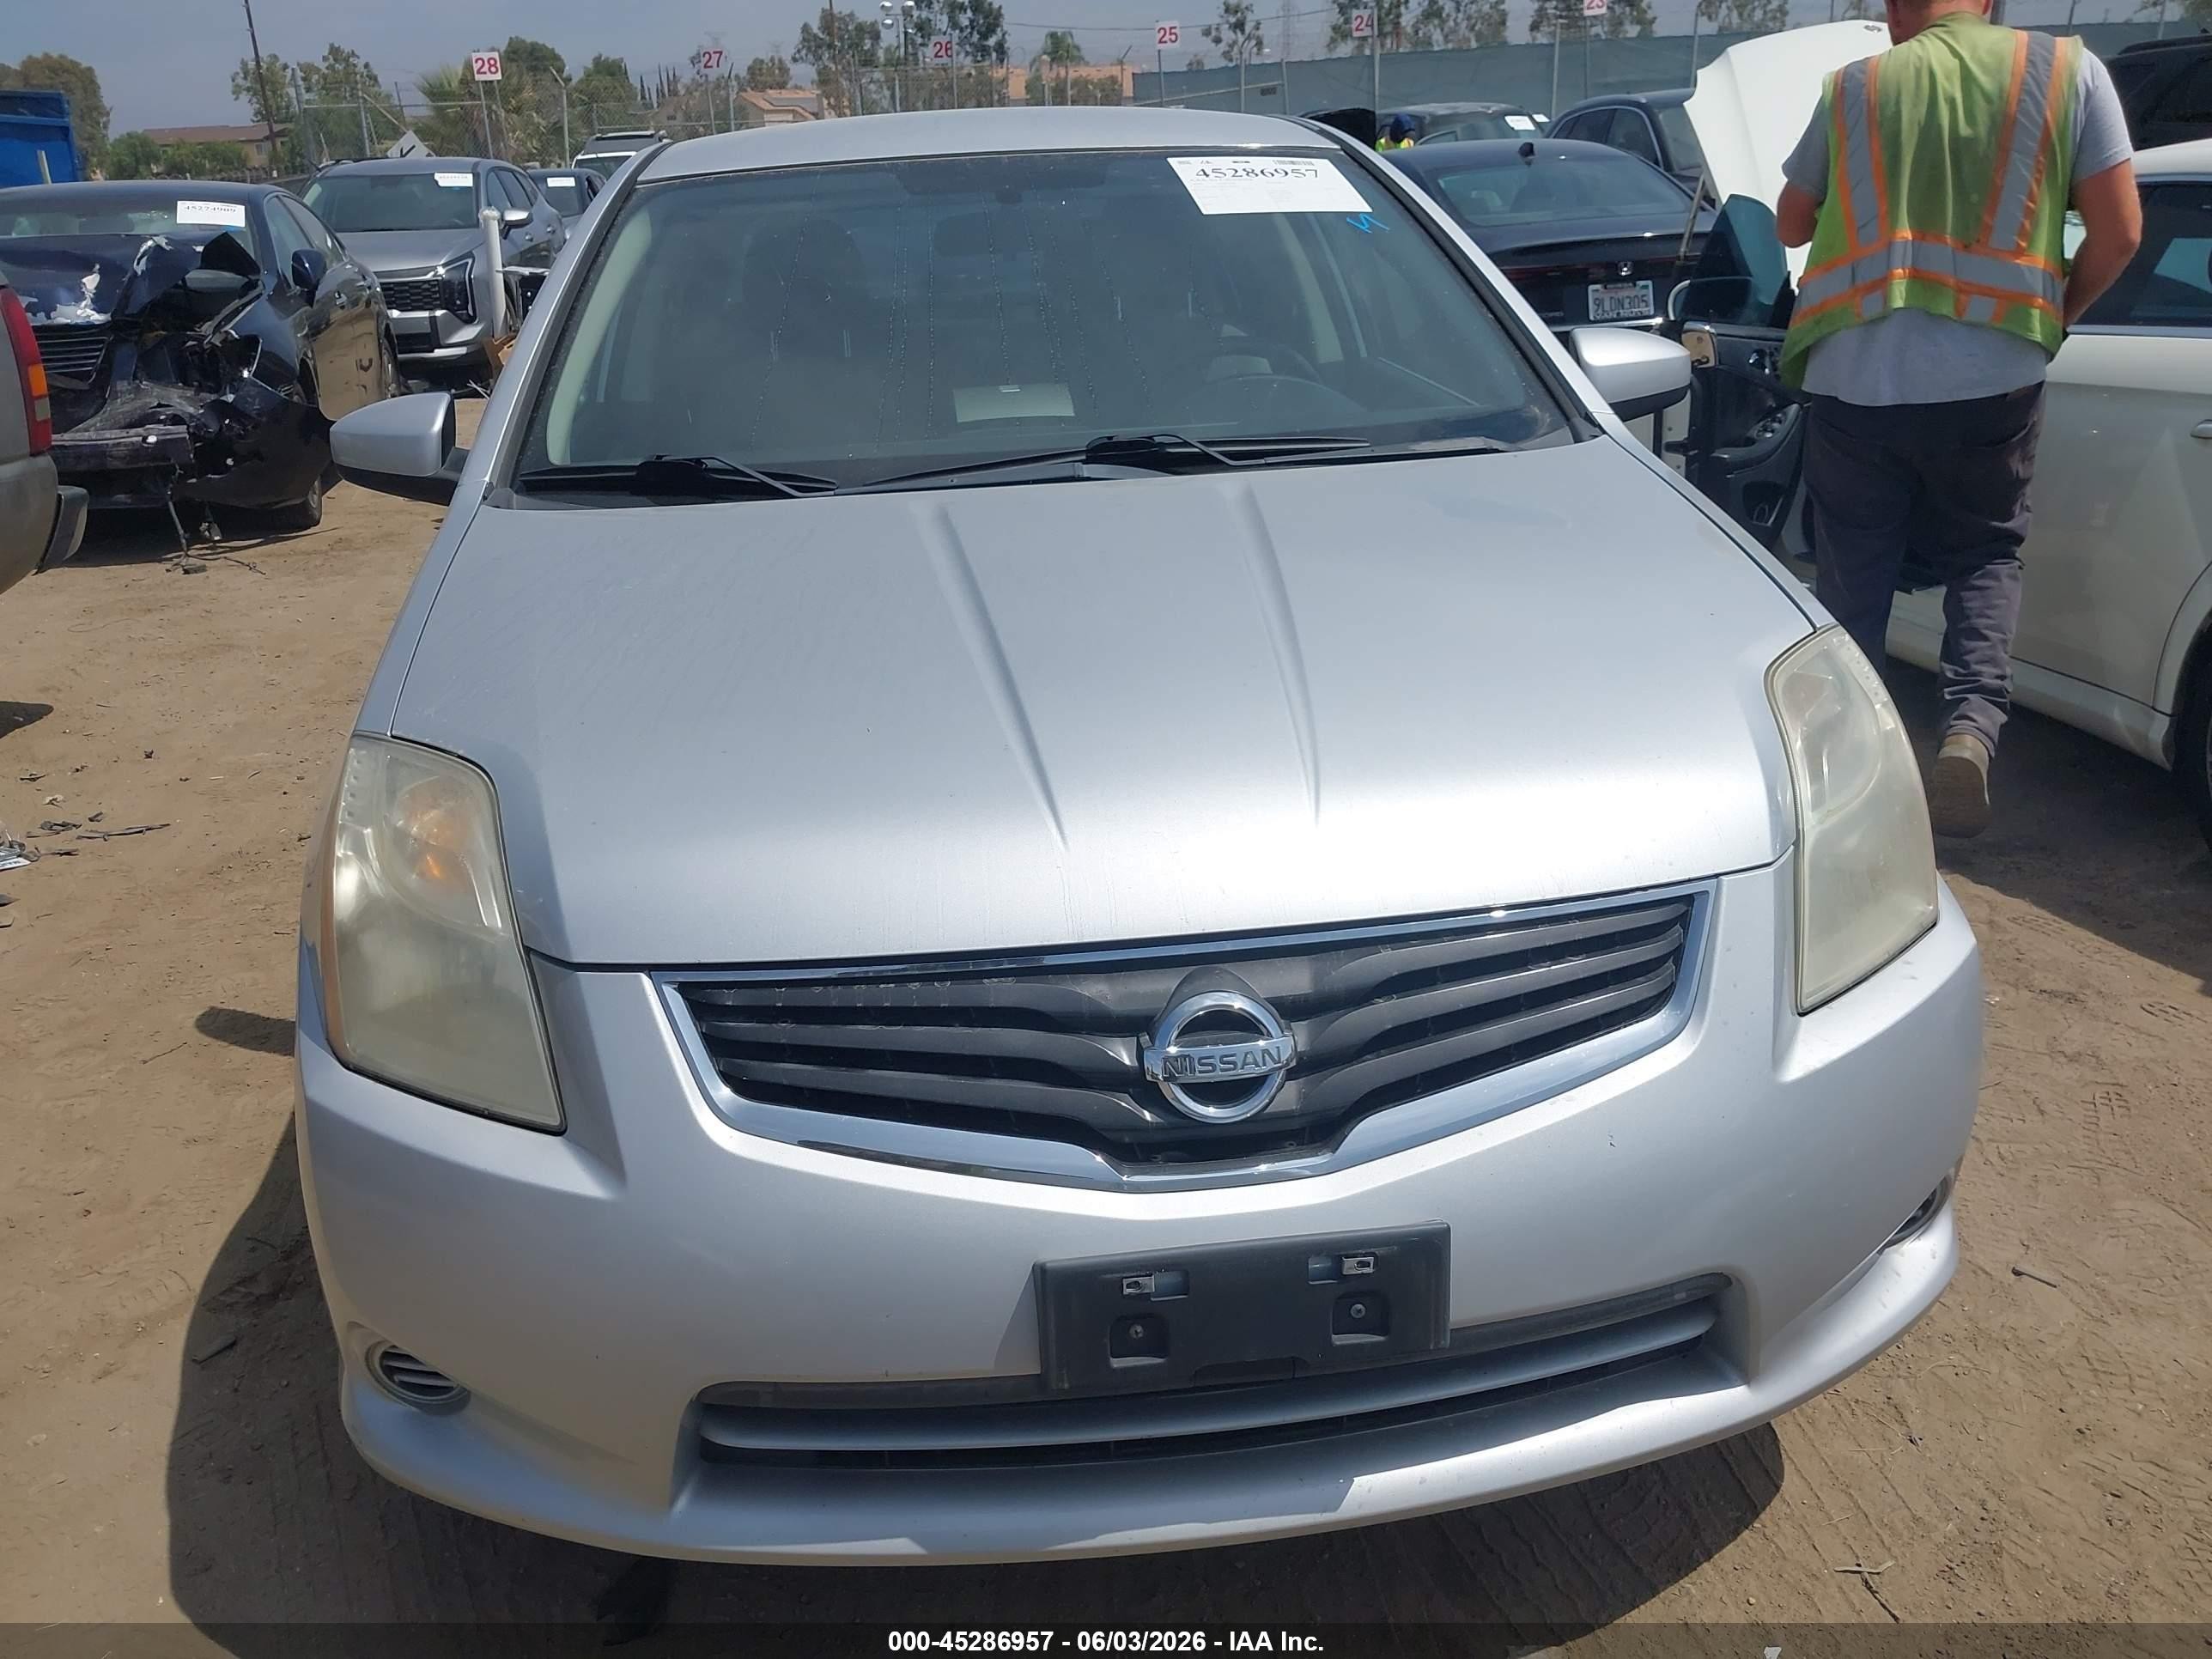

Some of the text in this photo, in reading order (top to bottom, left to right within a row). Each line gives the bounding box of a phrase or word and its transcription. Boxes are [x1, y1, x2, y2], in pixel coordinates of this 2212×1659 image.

[1354, 14, 1374, 31] 24
[1158, 27, 1178, 43] 25
[933, 40, 952, 58] 26
[474, 57, 499, 75] 28
[702, 51, 723, 69] 27
[1194, 167, 1318, 179] 45286957
[1161, 1045, 1283, 1079] NISSAN
